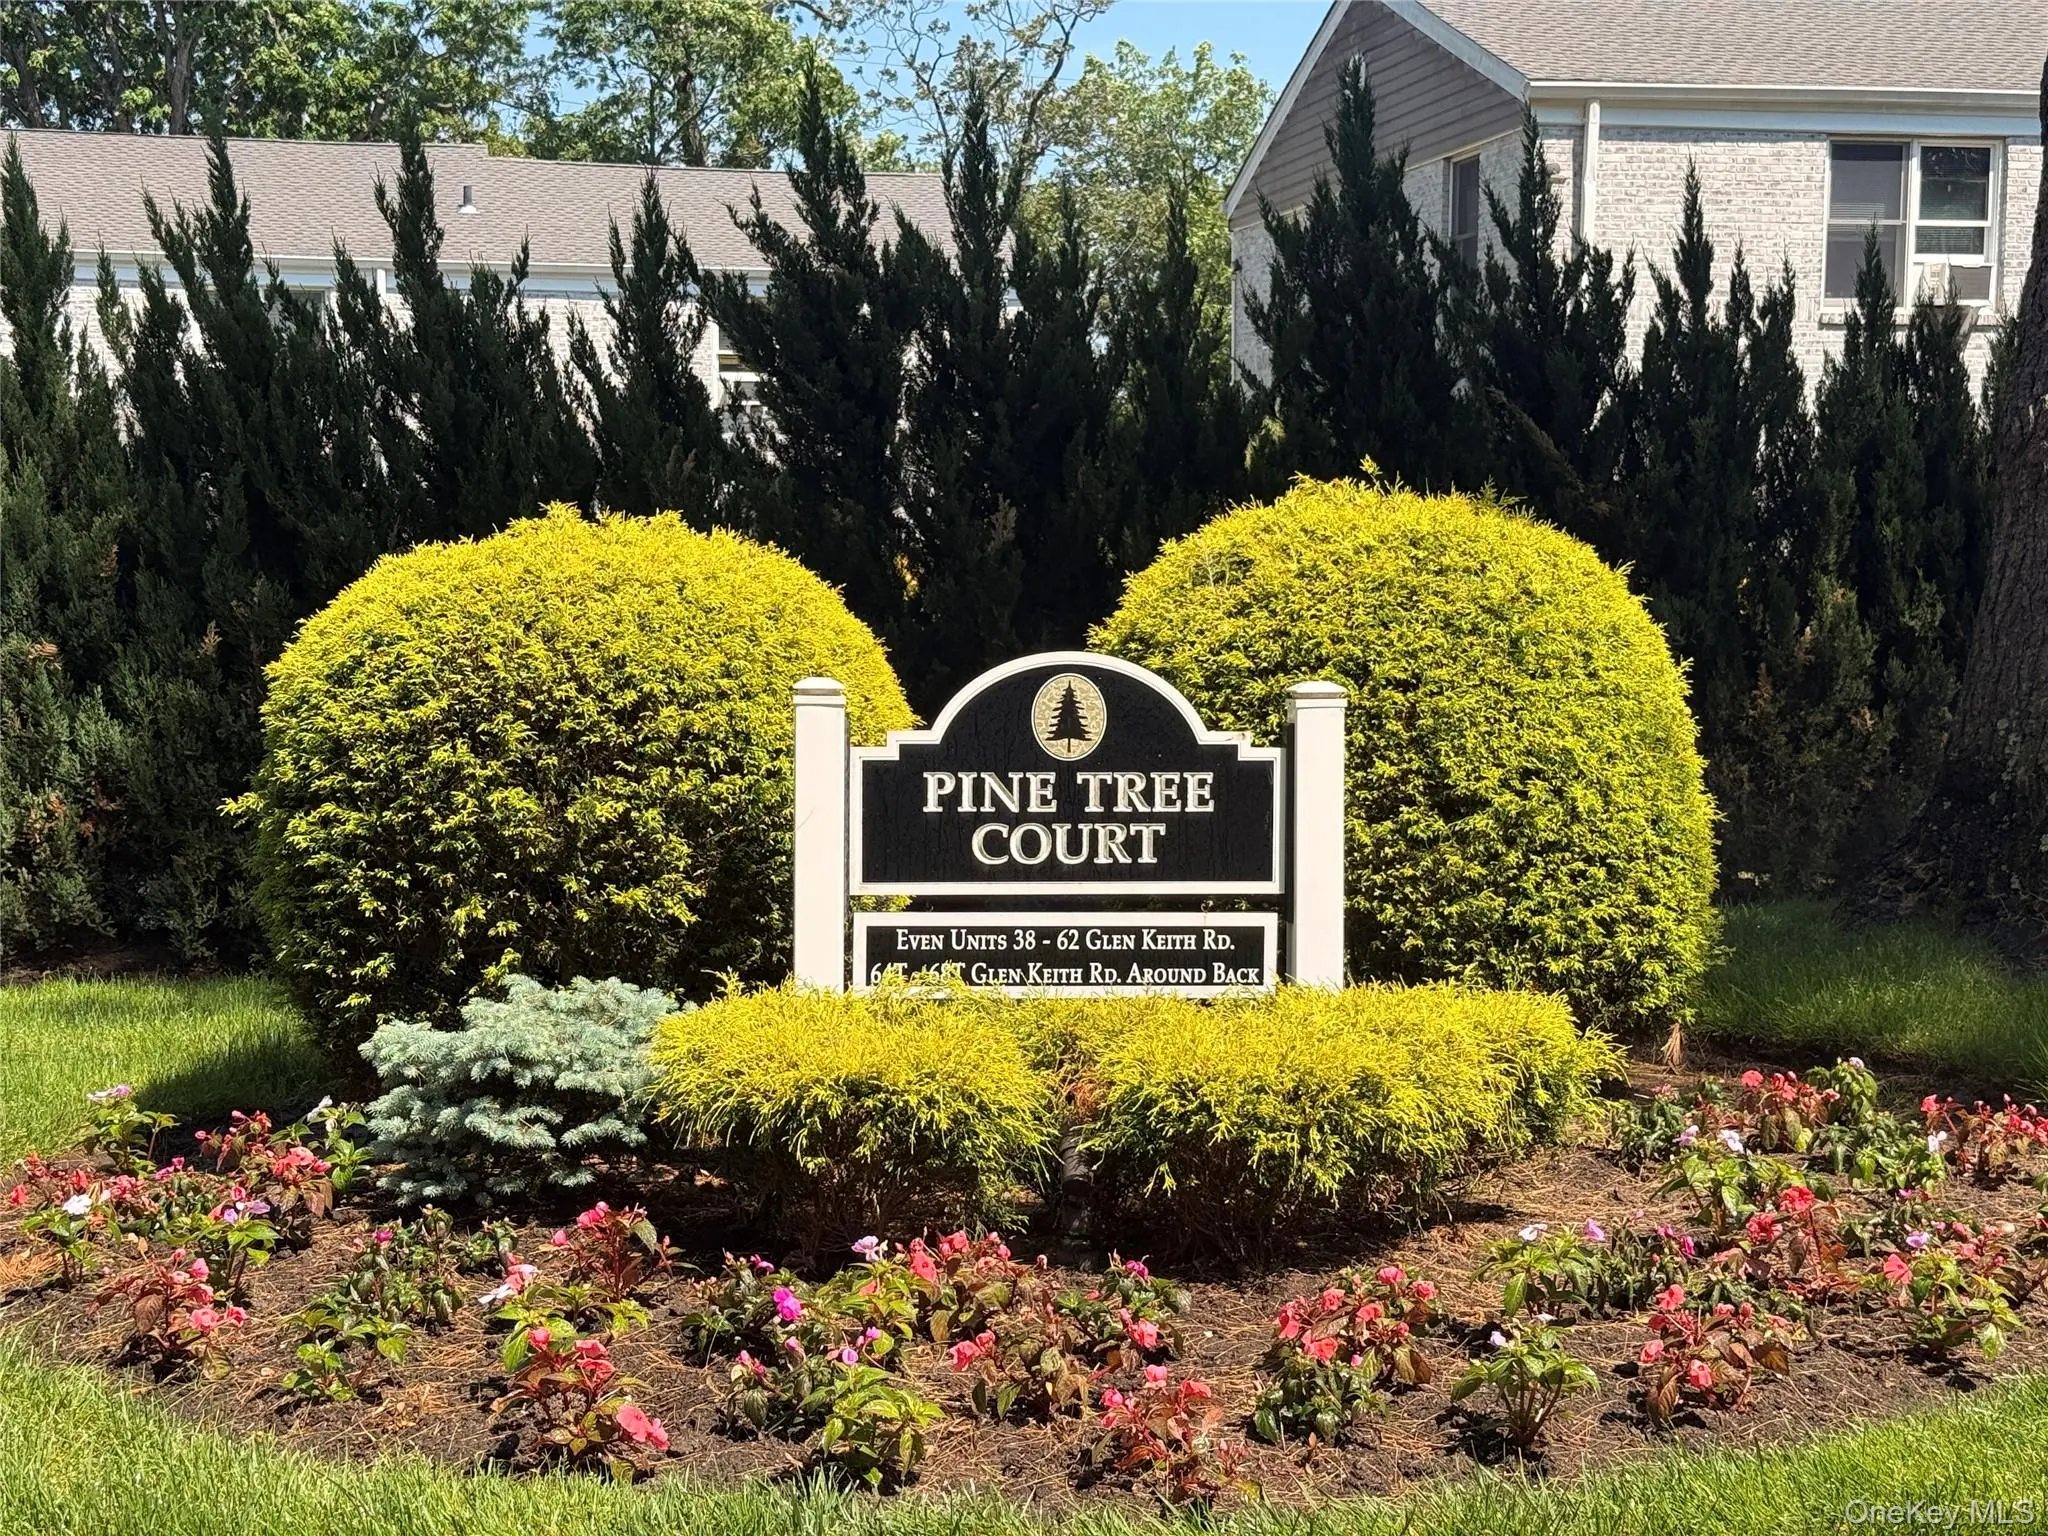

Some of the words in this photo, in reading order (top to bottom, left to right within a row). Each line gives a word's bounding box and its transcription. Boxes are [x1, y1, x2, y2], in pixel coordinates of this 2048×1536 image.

[922, 771, 1057, 813] PINE
[1077, 771, 1214, 813] TREE
[971, 823, 1166, 865] COURT
[1013, 929, 1036, 950] 38
[1057, 929, 1080, 950] 62
